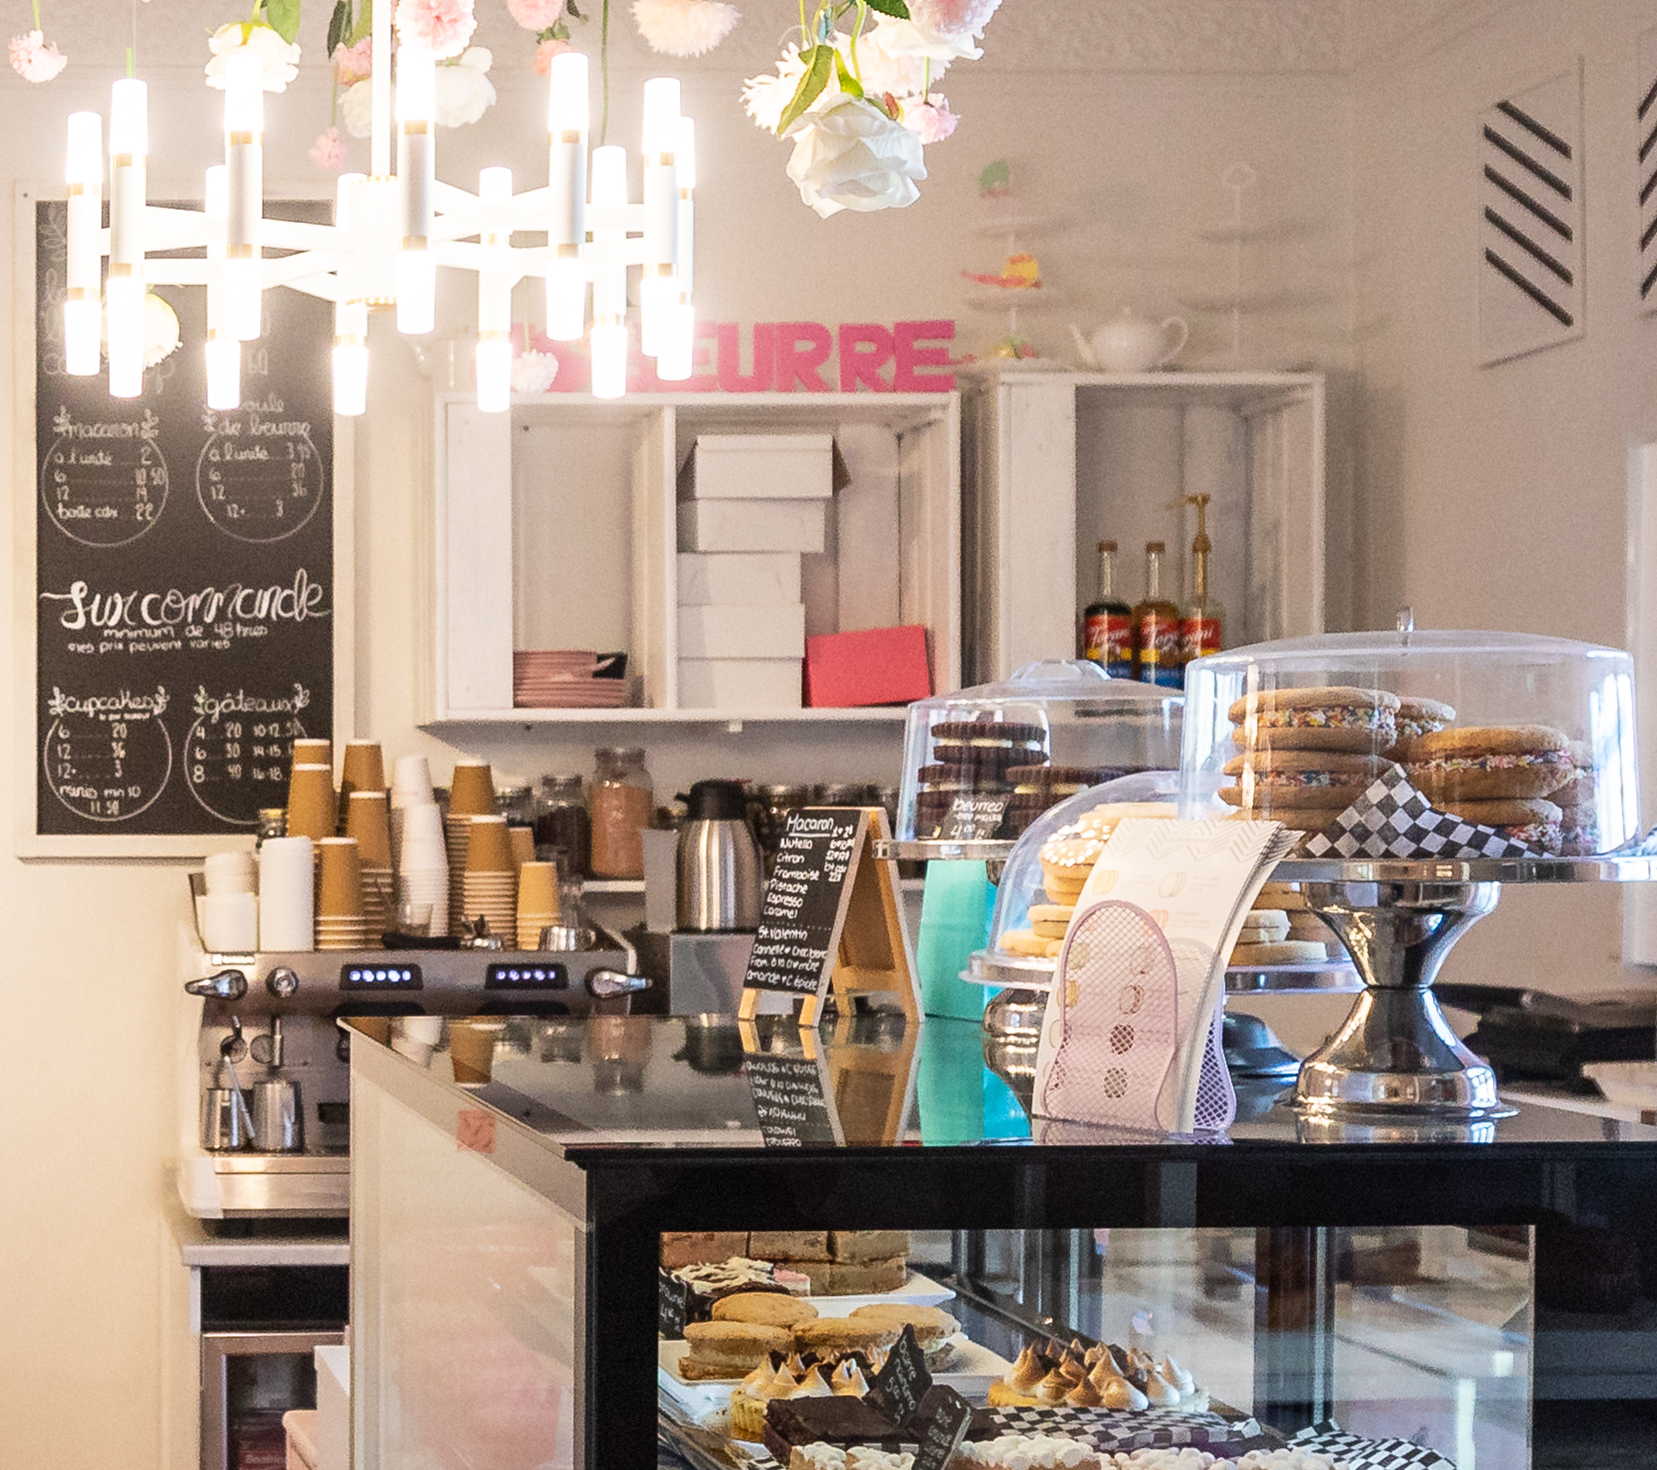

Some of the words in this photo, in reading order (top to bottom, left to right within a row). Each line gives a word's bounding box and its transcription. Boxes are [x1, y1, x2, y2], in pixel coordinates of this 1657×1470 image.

[186, 625, 203, 637] de
[215, 623, 234, 638] 48
[57, 745, 71, 759] 12
[193, 765, 205, 783] 8
[786, 814, 834, 831] Macaron
[780, 838, 813, 849] Nutella
[770, 880, 808, 894] Pistache
